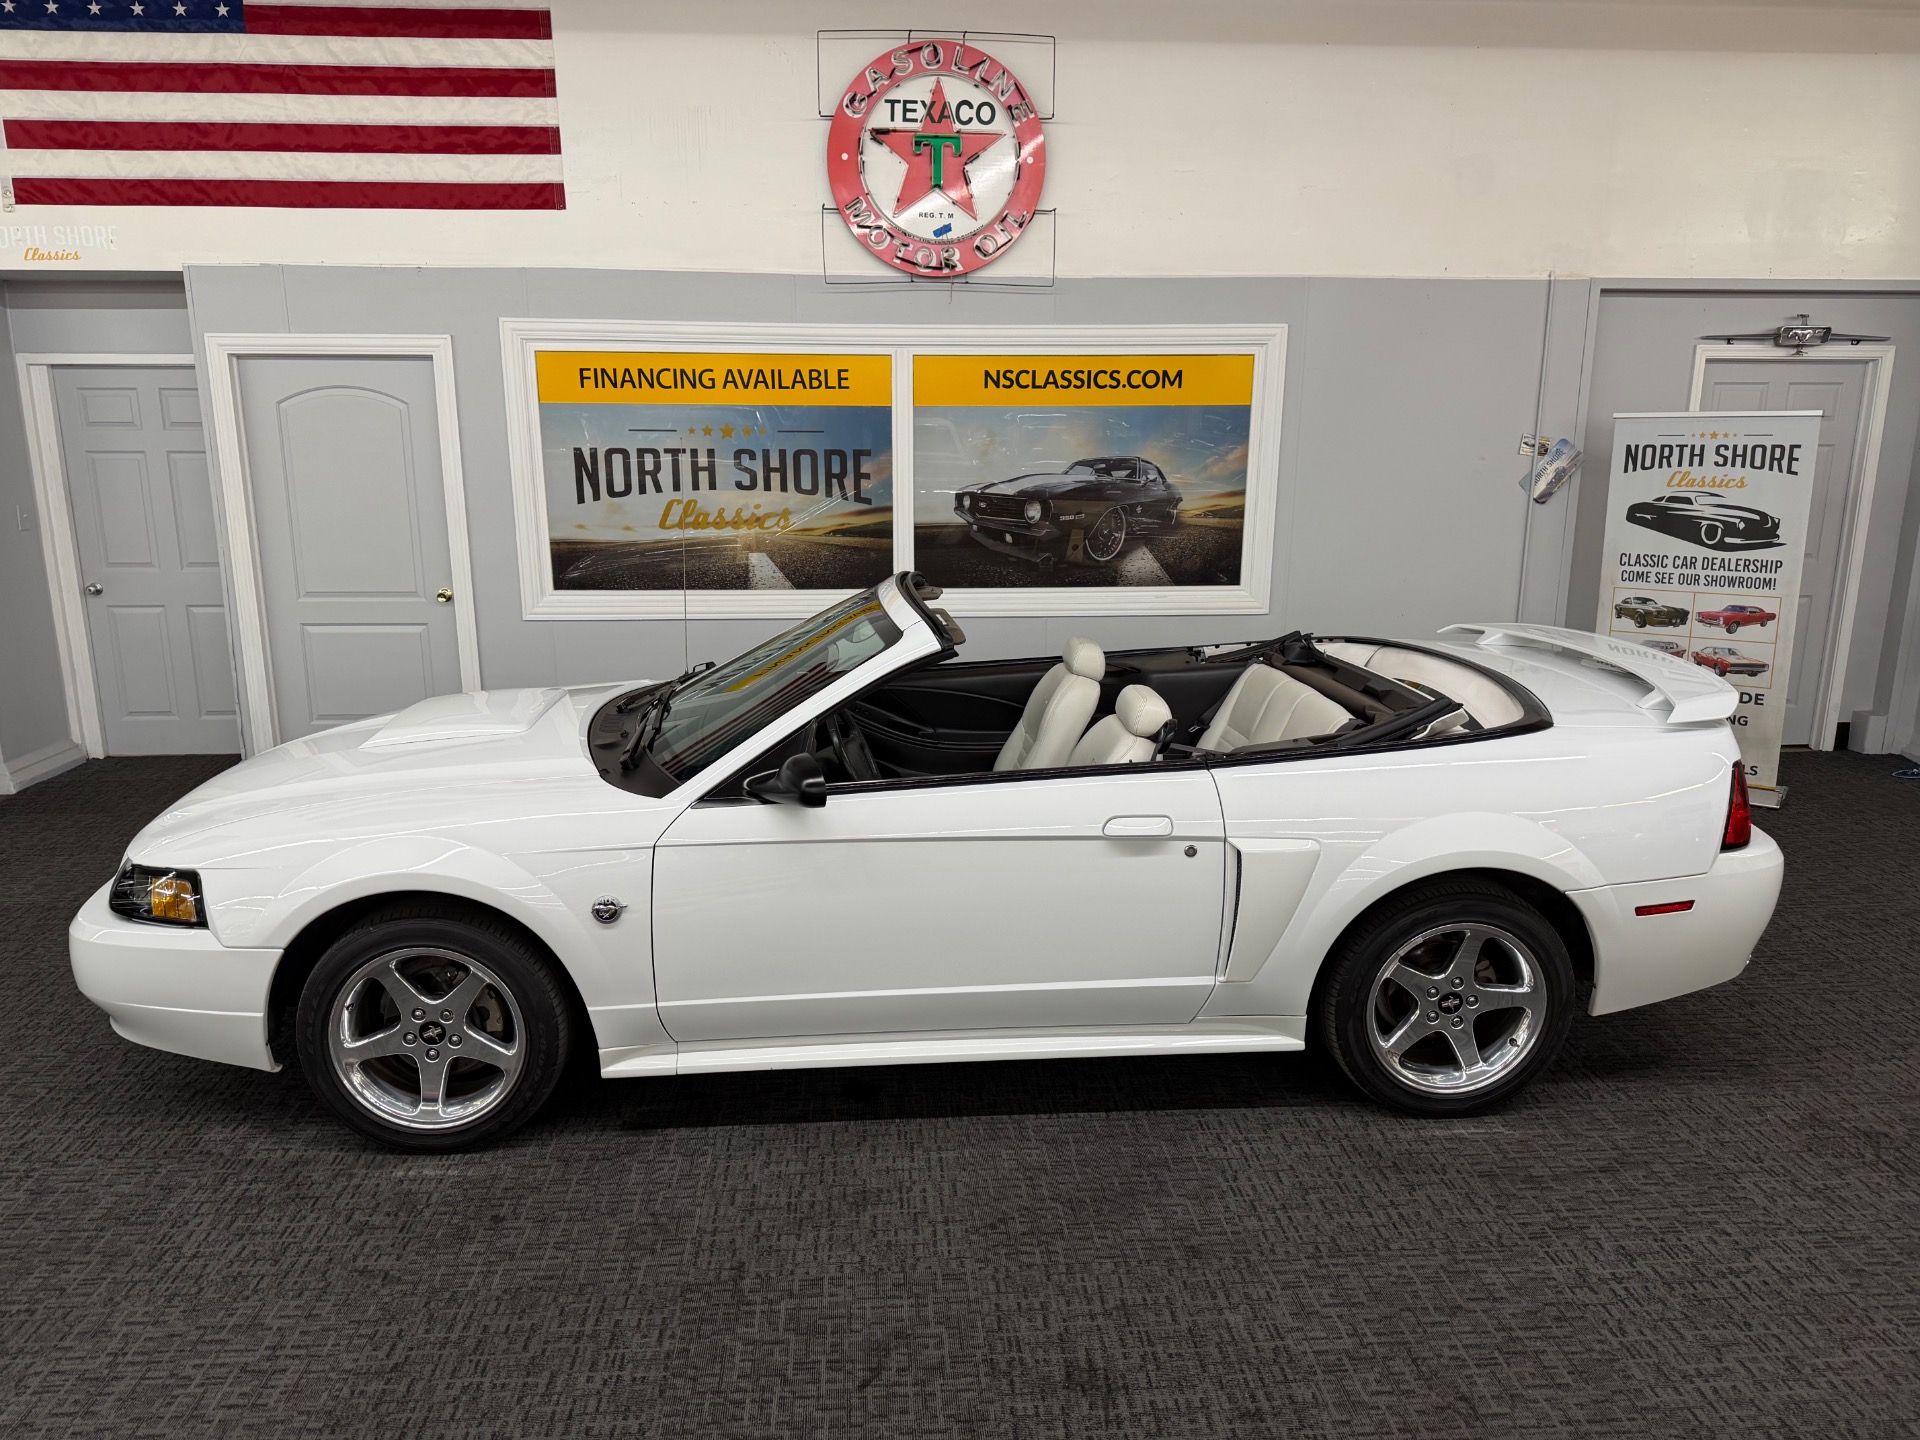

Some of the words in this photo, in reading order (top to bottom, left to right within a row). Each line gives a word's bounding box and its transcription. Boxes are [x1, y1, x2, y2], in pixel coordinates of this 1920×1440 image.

[843, 42, 1035, 127] GASOLINE
[884, 98, 996, 126] TEXACO
[912, 133, 963, 190] T
[918, 211, 938, 219] REG.
[53, 225, 118, 251] SHORE
[845, 196, 964, 273] MOTOR
[974, 210, 1030, 261] OIL
[23, 247, 82, 262] Classics
[578, 367, 717, 390] FINANCING
[721, 368, 850, 390] AVAILABLE
[983, 369, 1183, 390] NSCLASSICS.COM
[1623, 444, 1705, 474] NORTH
[1713, 444, 1802, 476] SHORE
[572, 446, 718, 505] NORTH
[733, 448, 873, 506] SHORE
[1666, 470, 1749, 489] Classics
[658, 497, 793, 532] Classics
[1619, 552, 1668, 569] CLASSIC
[1672, 555, 1698, 571] CAR
[1701, 556, 1783, 574] DEALERSHIP
[1620, 569, 1652, 584] COME
[1654, 572, 1674, 585] SEE
[1677, 573, 1701, 588] OUR
[1703, 574, 1777, 591] SHOWROOM!
